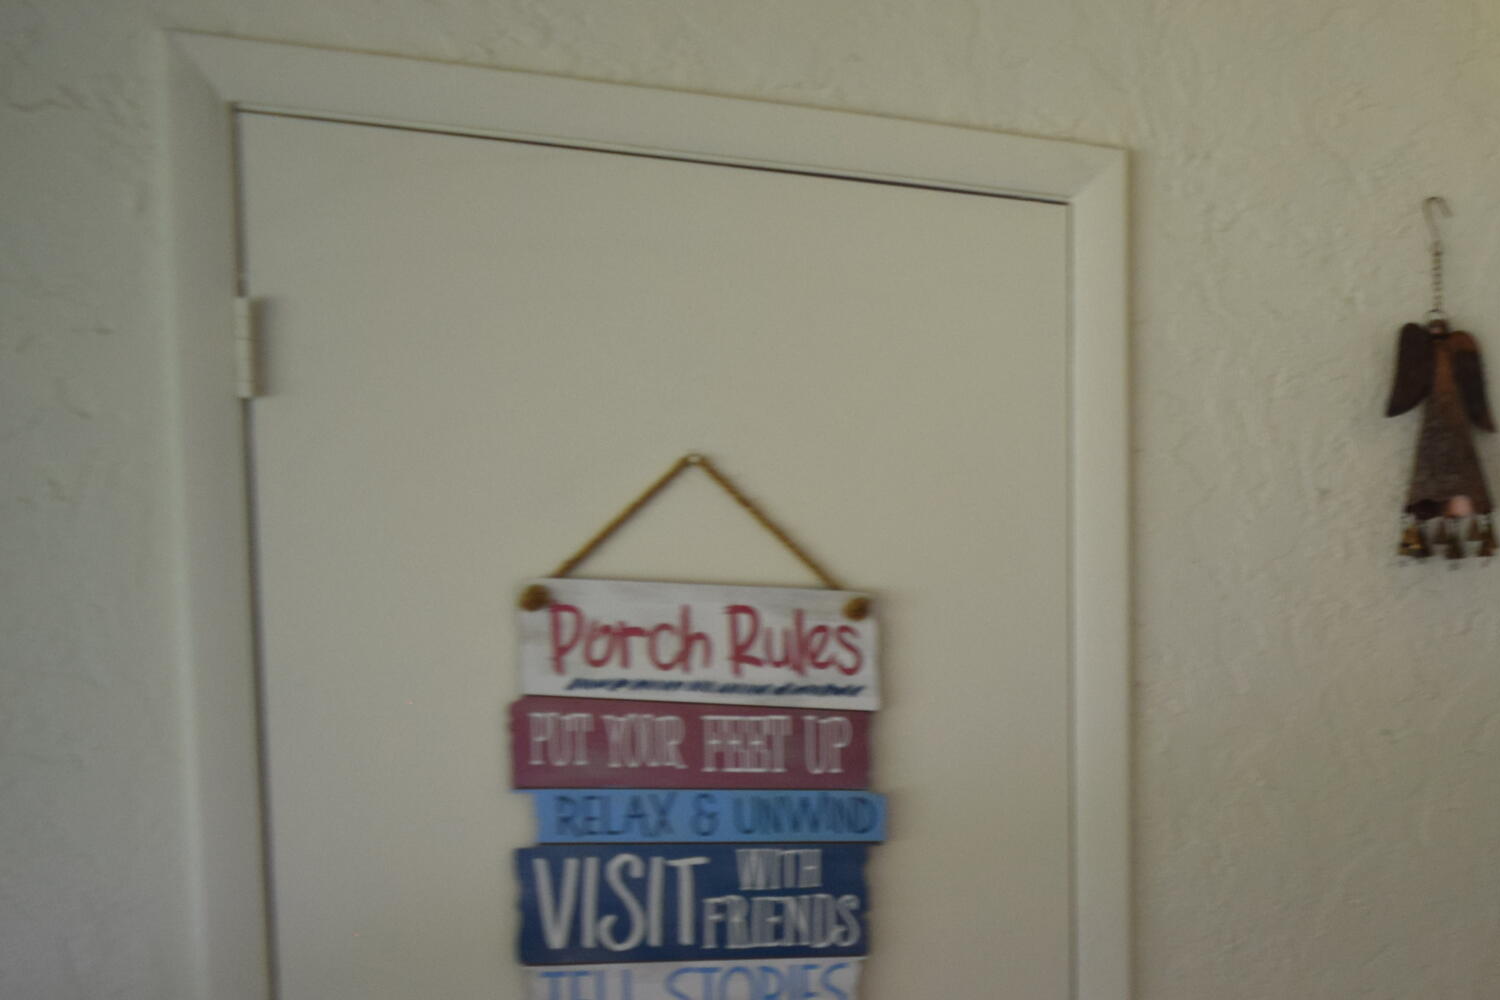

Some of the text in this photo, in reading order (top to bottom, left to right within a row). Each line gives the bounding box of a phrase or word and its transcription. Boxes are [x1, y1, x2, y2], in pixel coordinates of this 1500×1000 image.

[548, 603, 864, 677] Porch Rules
[526, 711, 855, 775] PUT YOUR FEET UP
[554, 792, 676, 837] RELAX
[731, 793, 877, 836] UNWIND
[531, 847, 823, 951] VISIT WITH
[700, 892, 861, 950] FRIENDS
